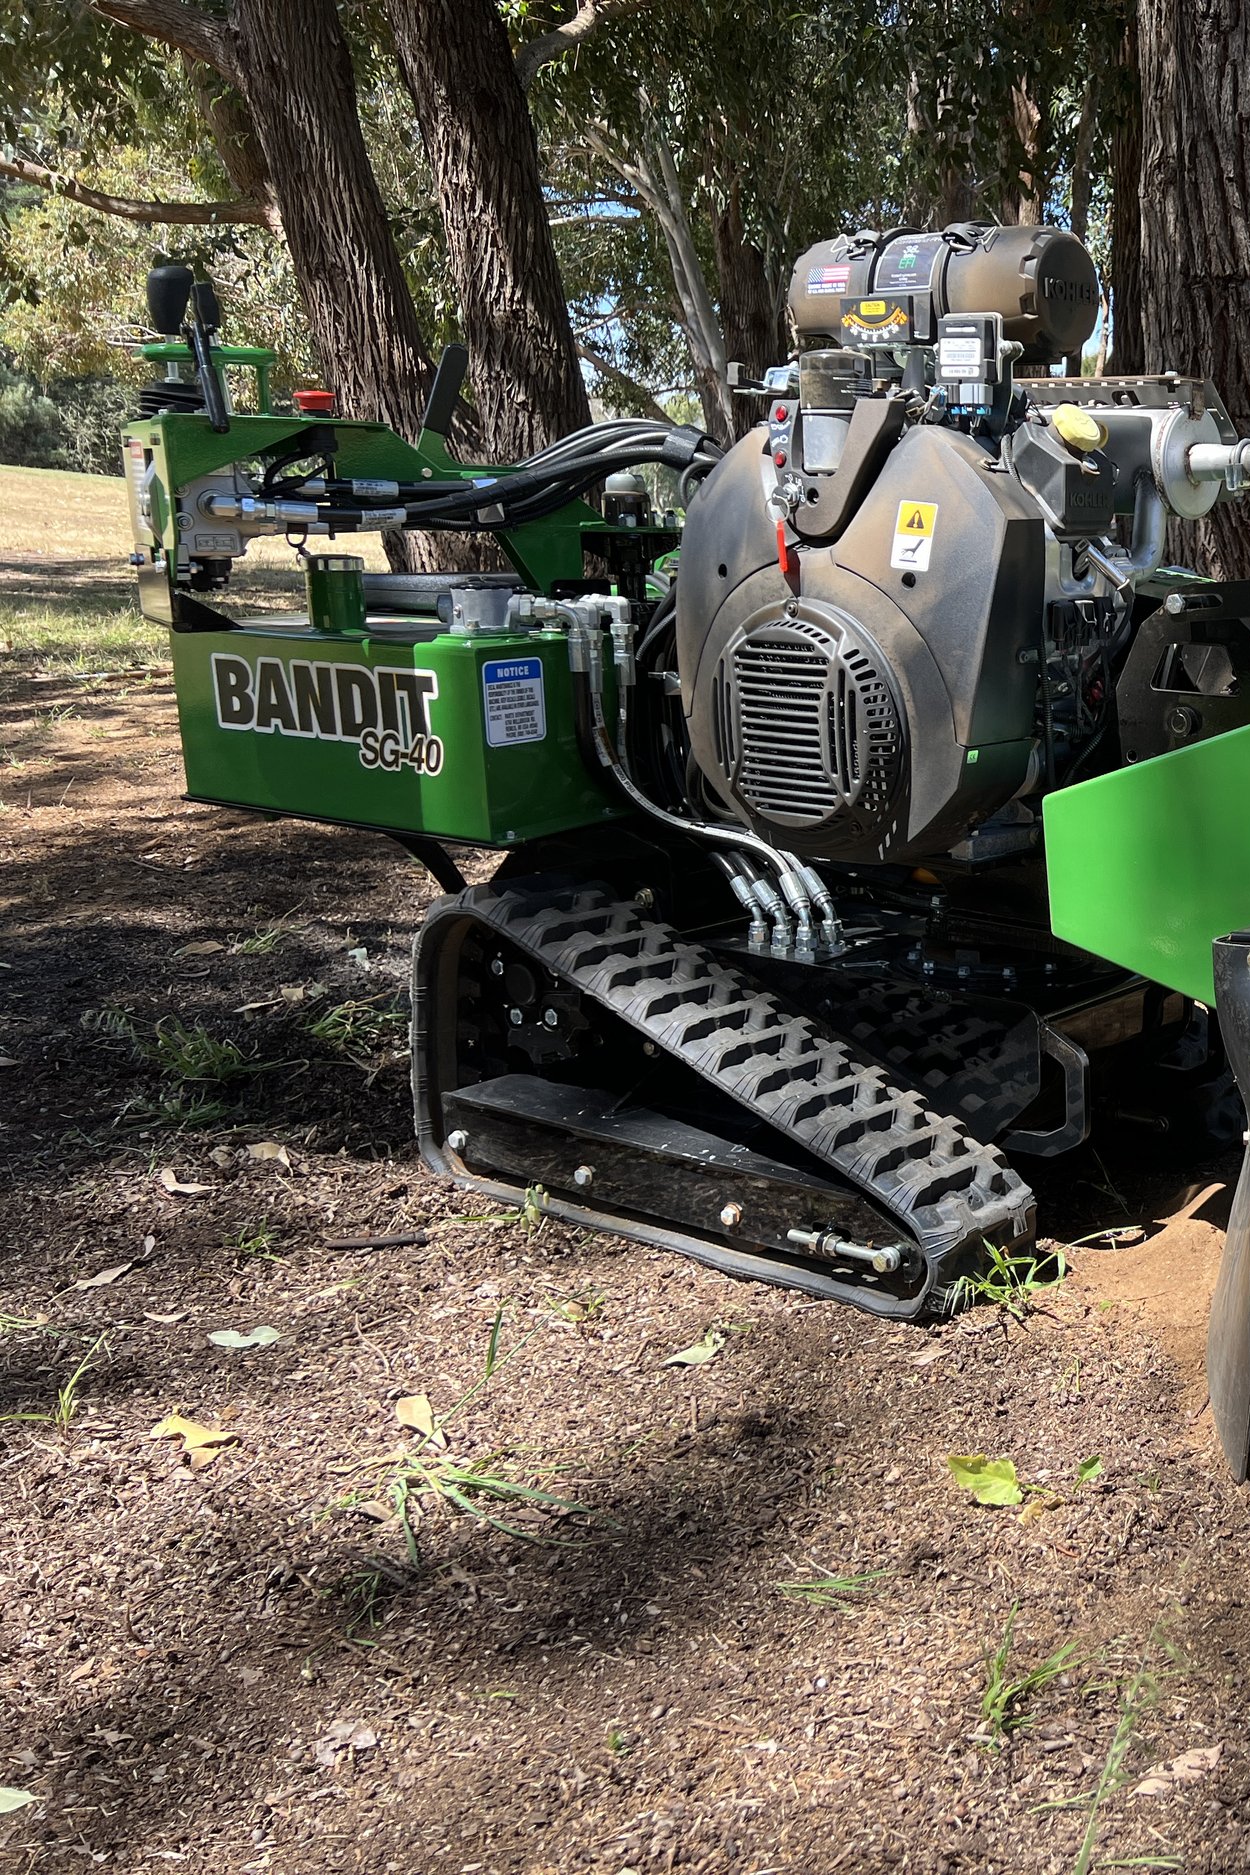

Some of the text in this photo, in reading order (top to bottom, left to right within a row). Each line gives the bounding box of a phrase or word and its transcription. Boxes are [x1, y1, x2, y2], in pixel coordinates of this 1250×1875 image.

[1069, 492, 1109, 509] KOHL
[496, 666, 529, 678] NOTICE
[213, 656, 436, 741] BANDIT
[360, 730, 442, 773] SG-40
